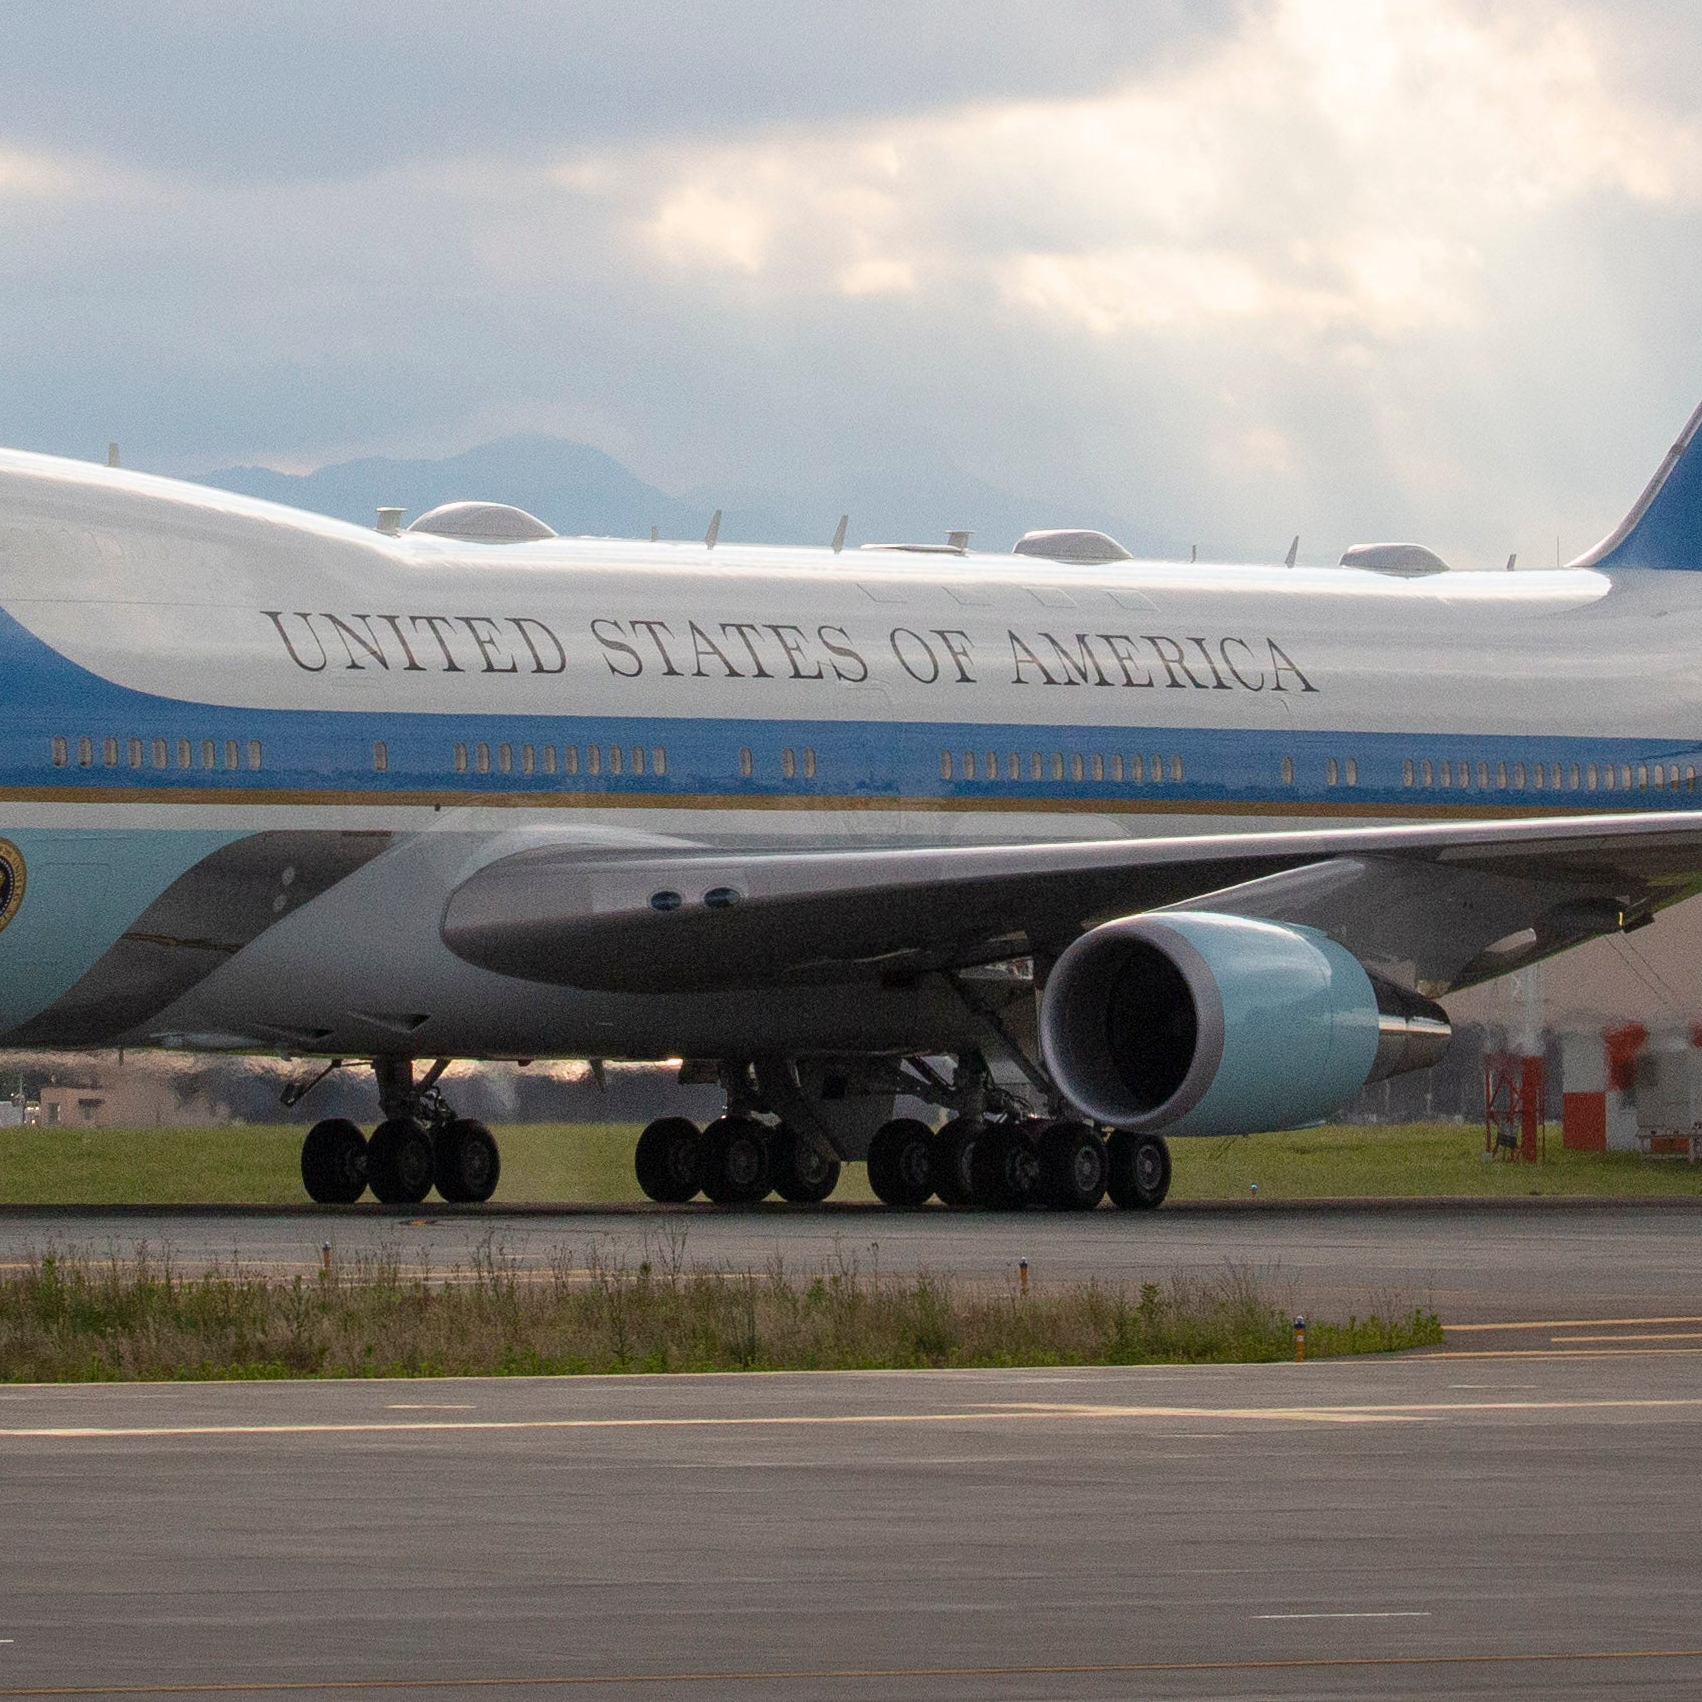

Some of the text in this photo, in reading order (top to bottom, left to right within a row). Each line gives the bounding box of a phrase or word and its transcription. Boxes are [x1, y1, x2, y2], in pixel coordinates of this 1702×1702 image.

[259, 610, 1320, 693] UNITED STATES OF AMERICA
